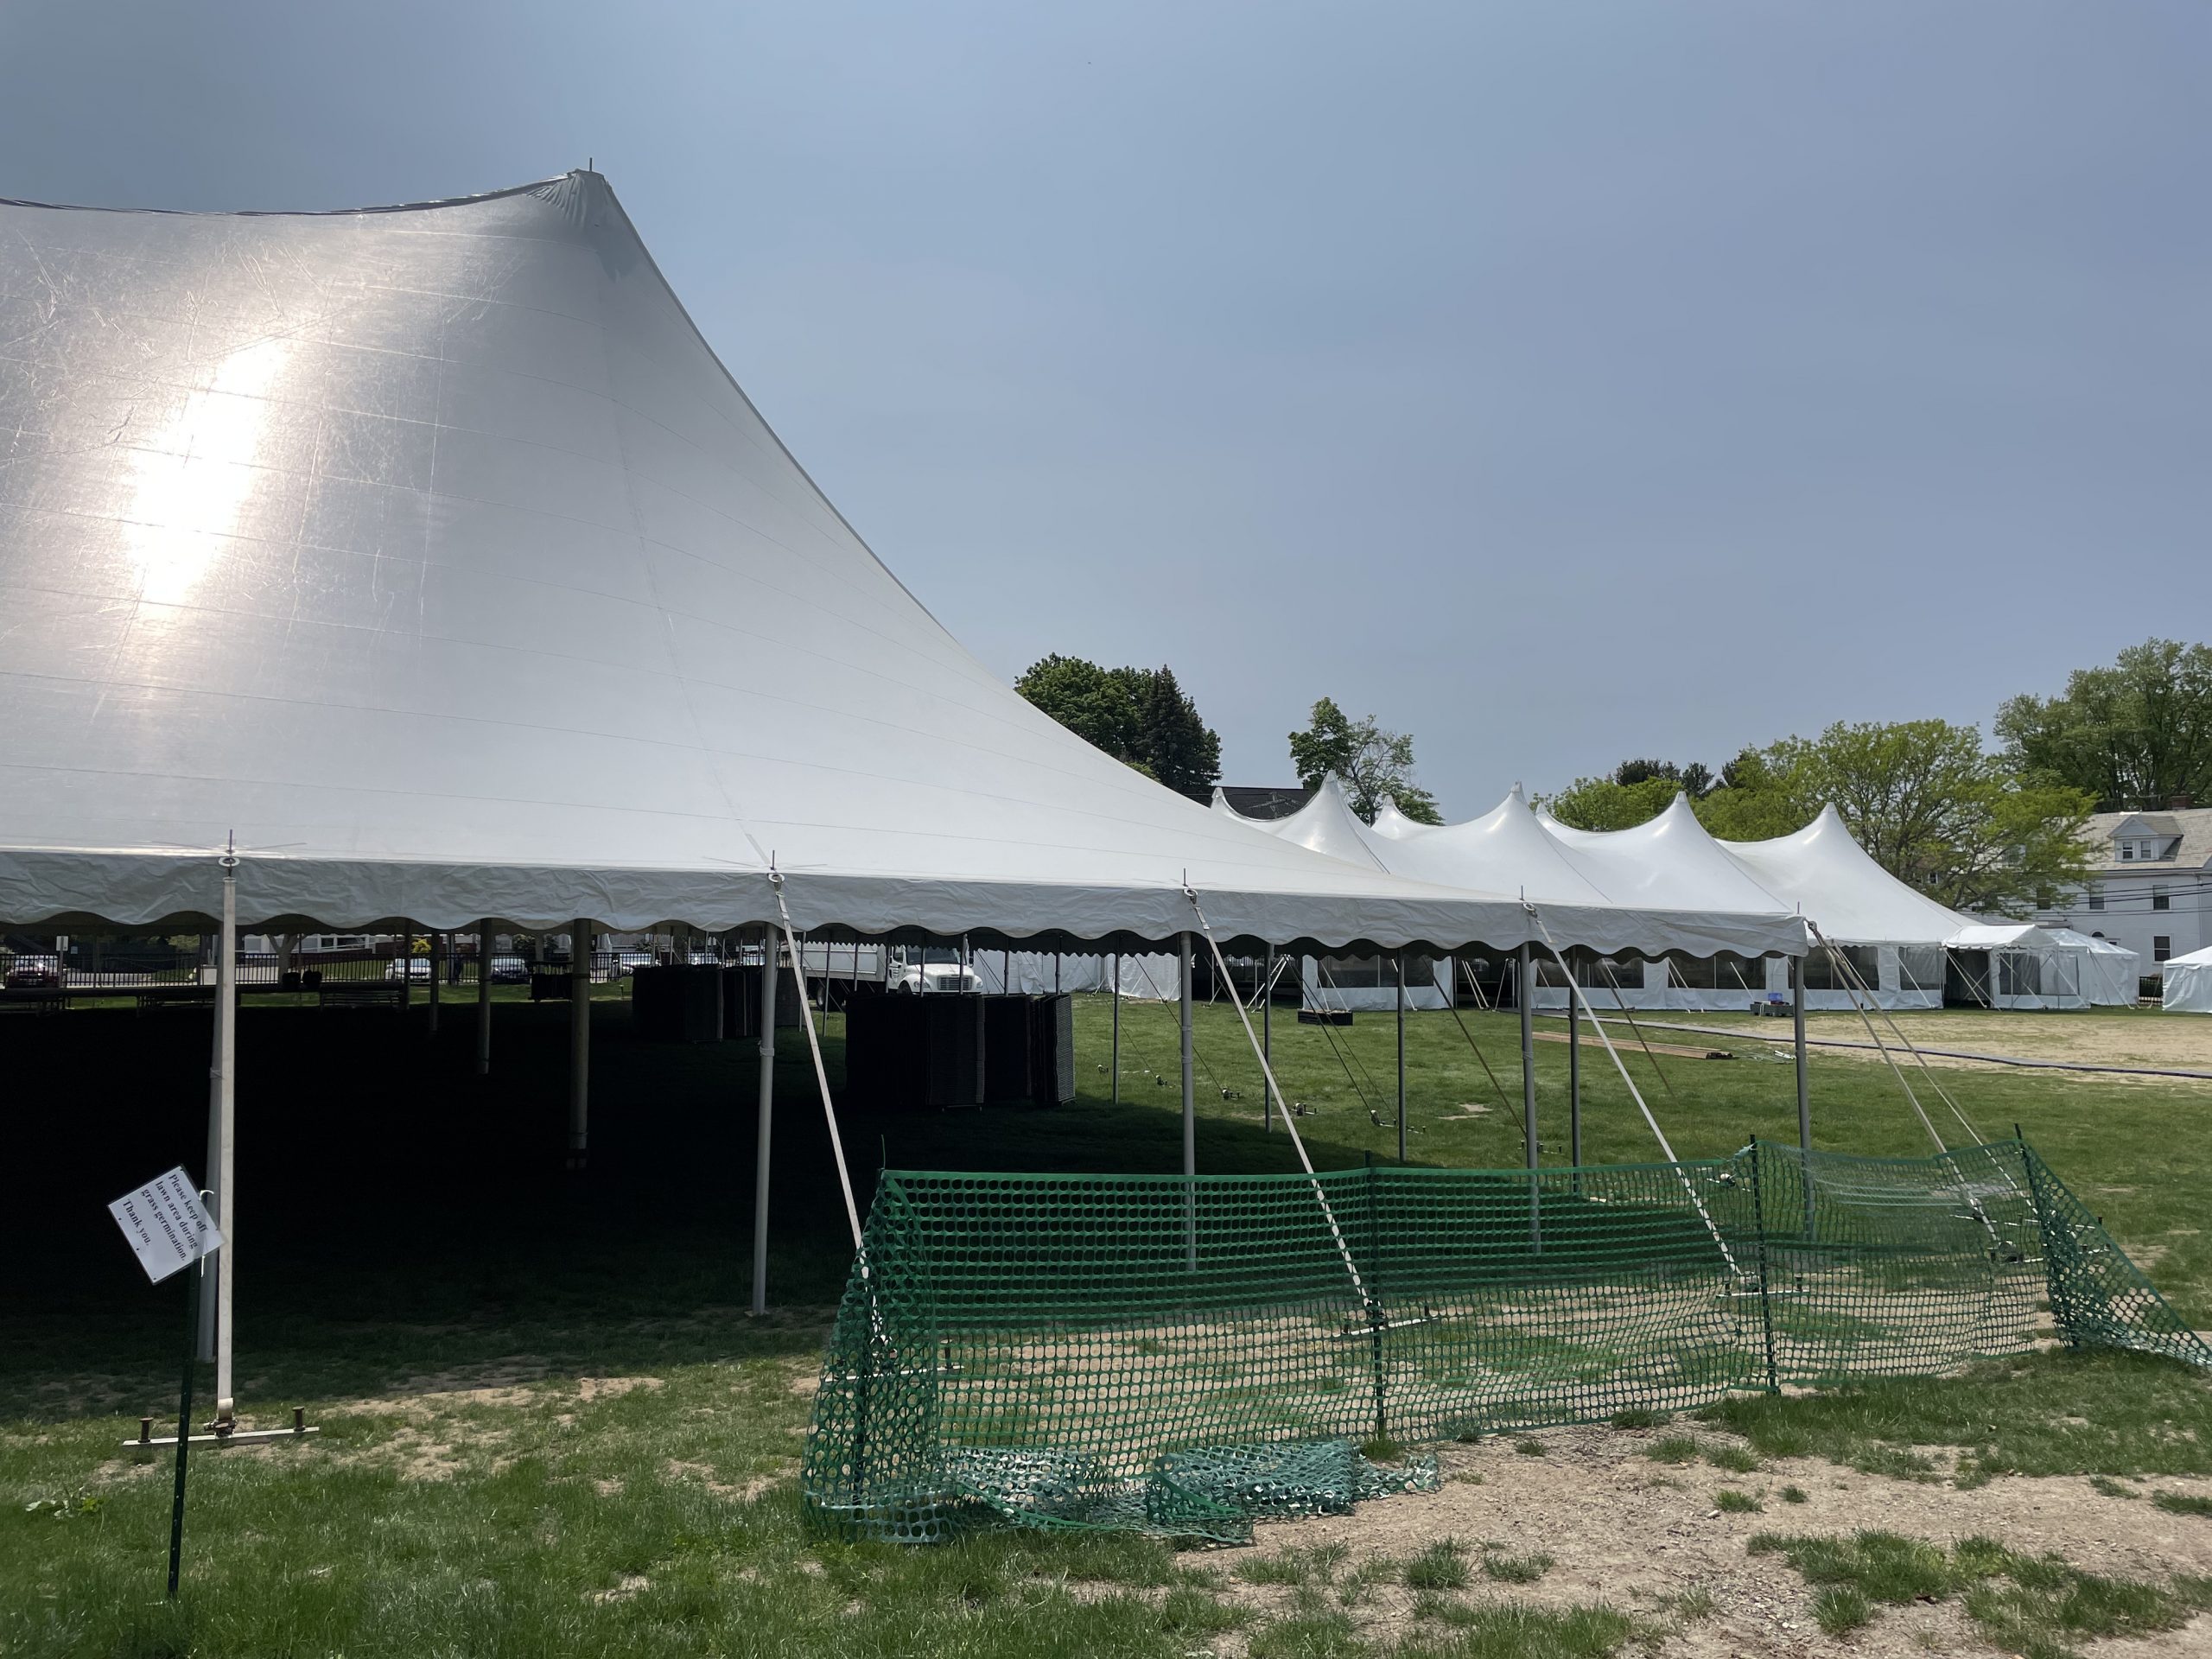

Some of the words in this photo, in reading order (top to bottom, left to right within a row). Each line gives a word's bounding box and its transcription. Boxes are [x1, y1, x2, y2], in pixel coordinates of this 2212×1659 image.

[123, 1198, 142, 1228] Thank
[137, 1227, 151, 1246] you.
[141, 1189, 158, 1211] grass
[154, 1211, 188, 1261] germination.
[155, 1181, 170, 1202] lawn
[168, 1203, 181, 1221] area
[179, 1221, 199, 1249] during
[168, 1174, 187, 1200] Please
[184, 1199, 198, 1220] keep
[196, 1221, 207, 1232] off
